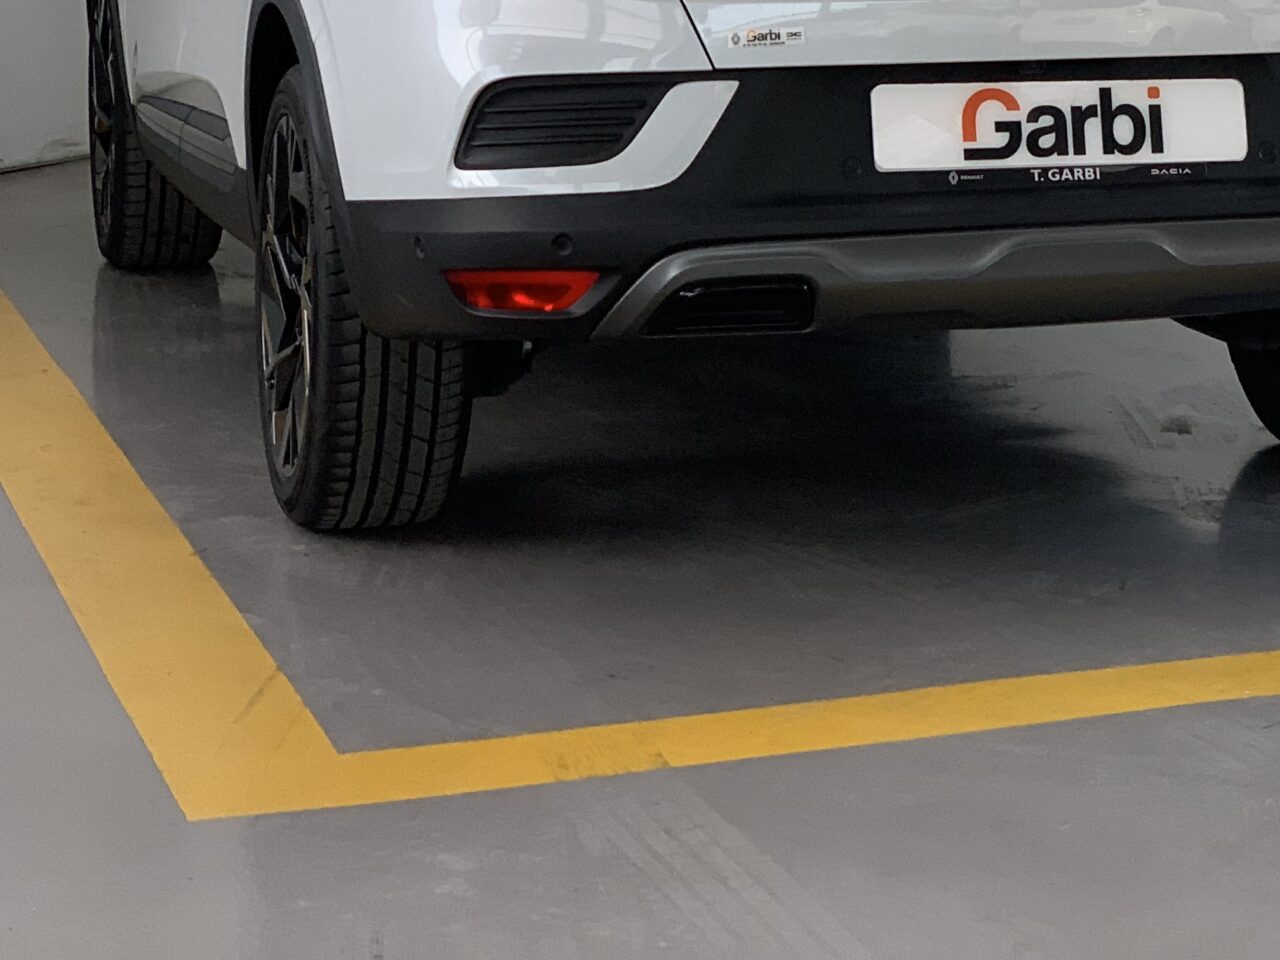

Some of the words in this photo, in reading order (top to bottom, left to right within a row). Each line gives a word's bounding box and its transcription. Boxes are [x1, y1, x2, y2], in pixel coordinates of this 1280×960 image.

[746, 28, 781, 43] Garbi
[961, 86, 1164, 161] Garbi
[1030, 169, 1045, 182] T.
[1048, 167, 1100, 182] GARBI
[1150, 168, 1192, 176] DACIA
